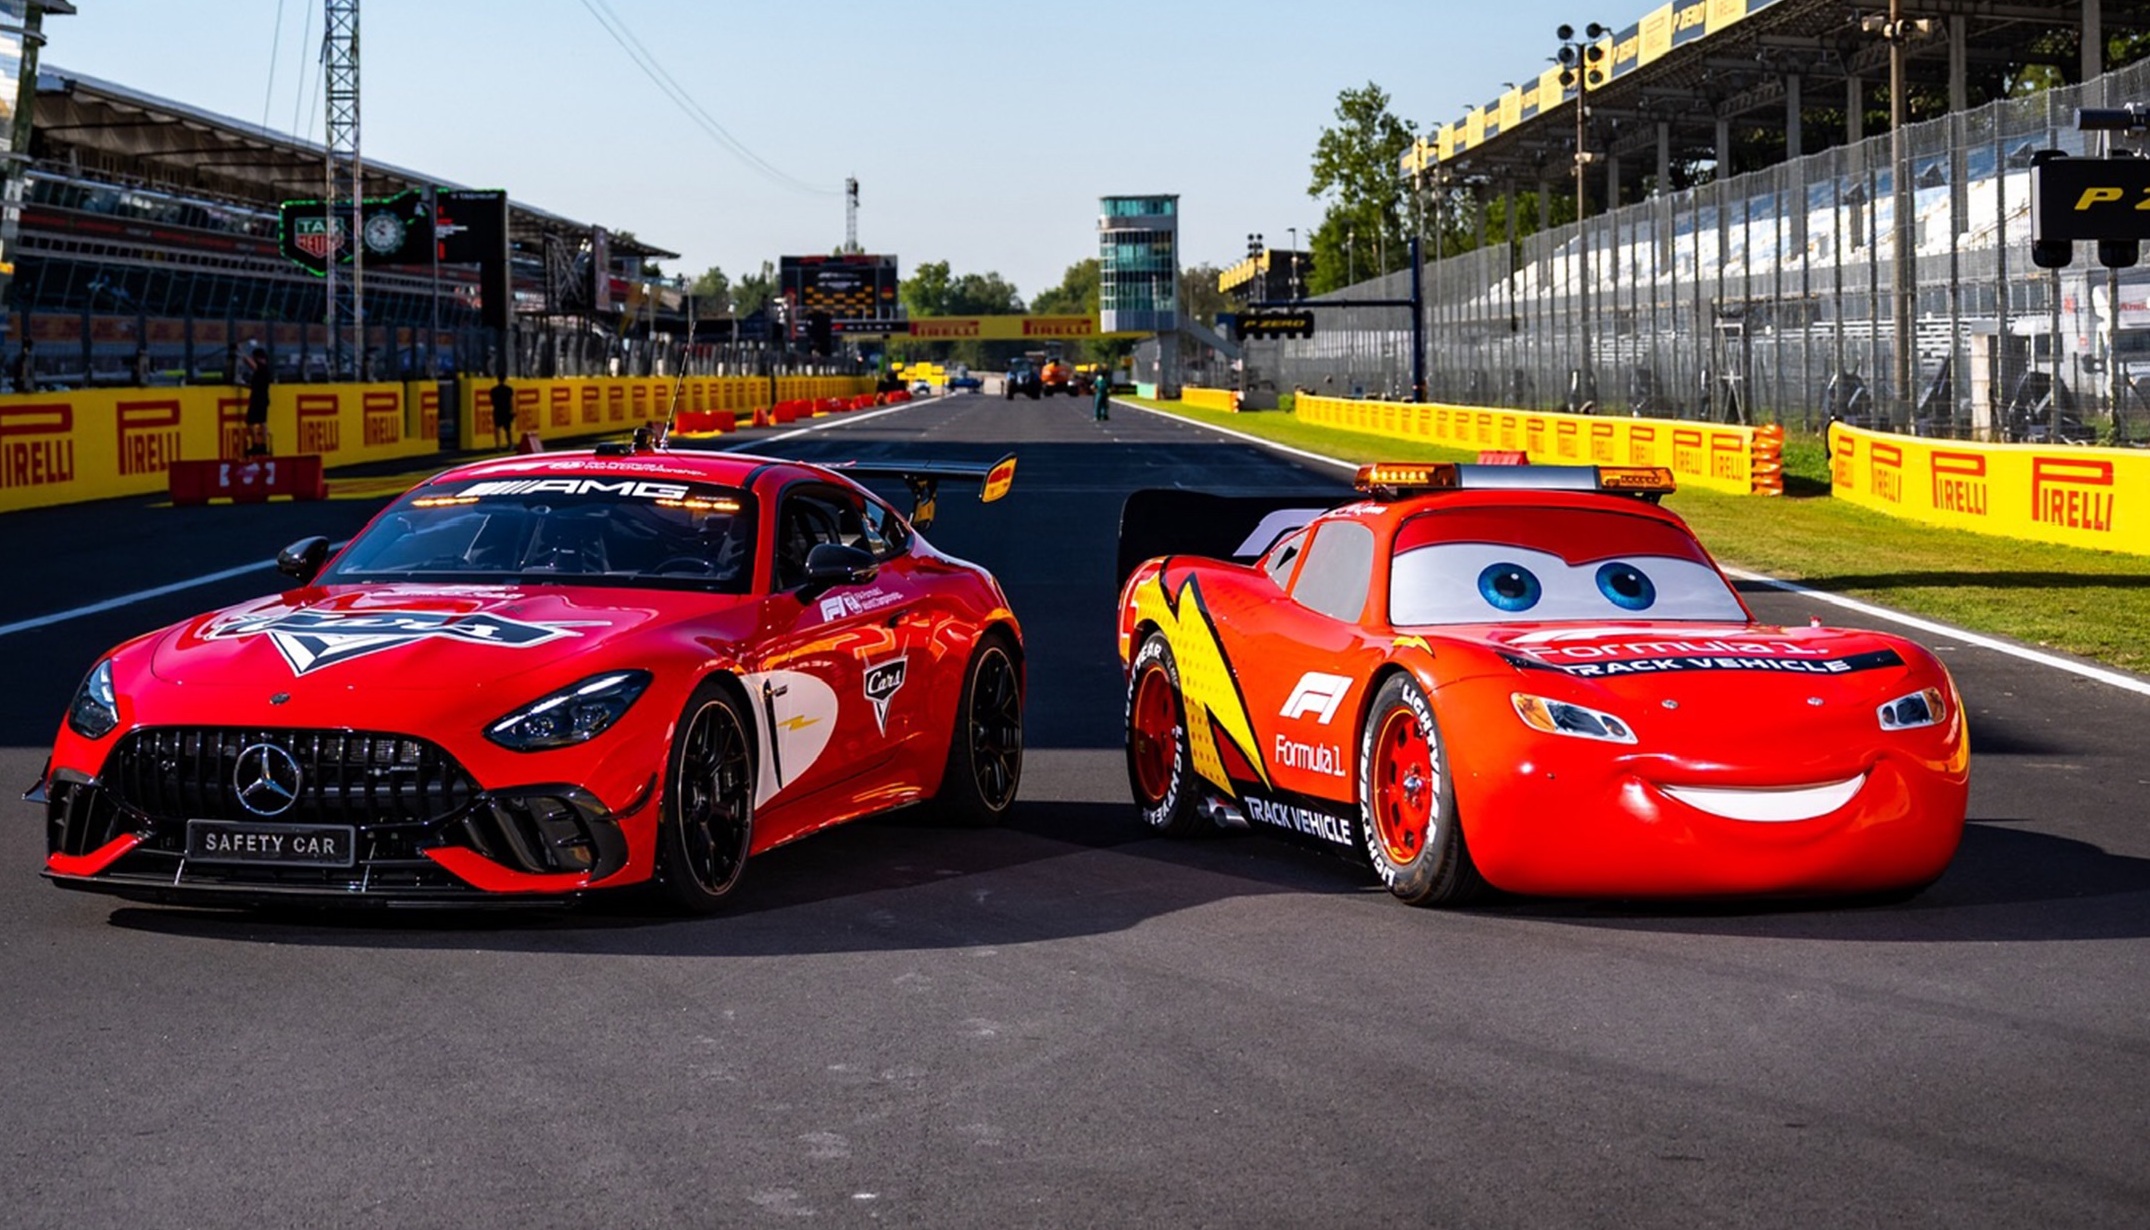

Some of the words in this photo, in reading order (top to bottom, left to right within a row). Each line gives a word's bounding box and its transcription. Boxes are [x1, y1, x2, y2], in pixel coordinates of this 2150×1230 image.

[2074, 188, 2123, 210] P
[522, 480, 689, 499] AMG
[1931, 451, 1986, 515] PIRELLI
[2032, 457, 2113, 531] PIRELLI
[1520, 640, 1776, 659] Formula
[1562, 658, 1683, 676] TRACK
[1687, 657, 1852, 673] VEHICLE
[867, 670, 901, 694] Cars
[1244, 796, 1292, 829] TRACK
[1291, 806, 1353, 846] VEHICLE
[206, 832, 283, 854] SAFETY
[293, 834, 335, 855] CAR
